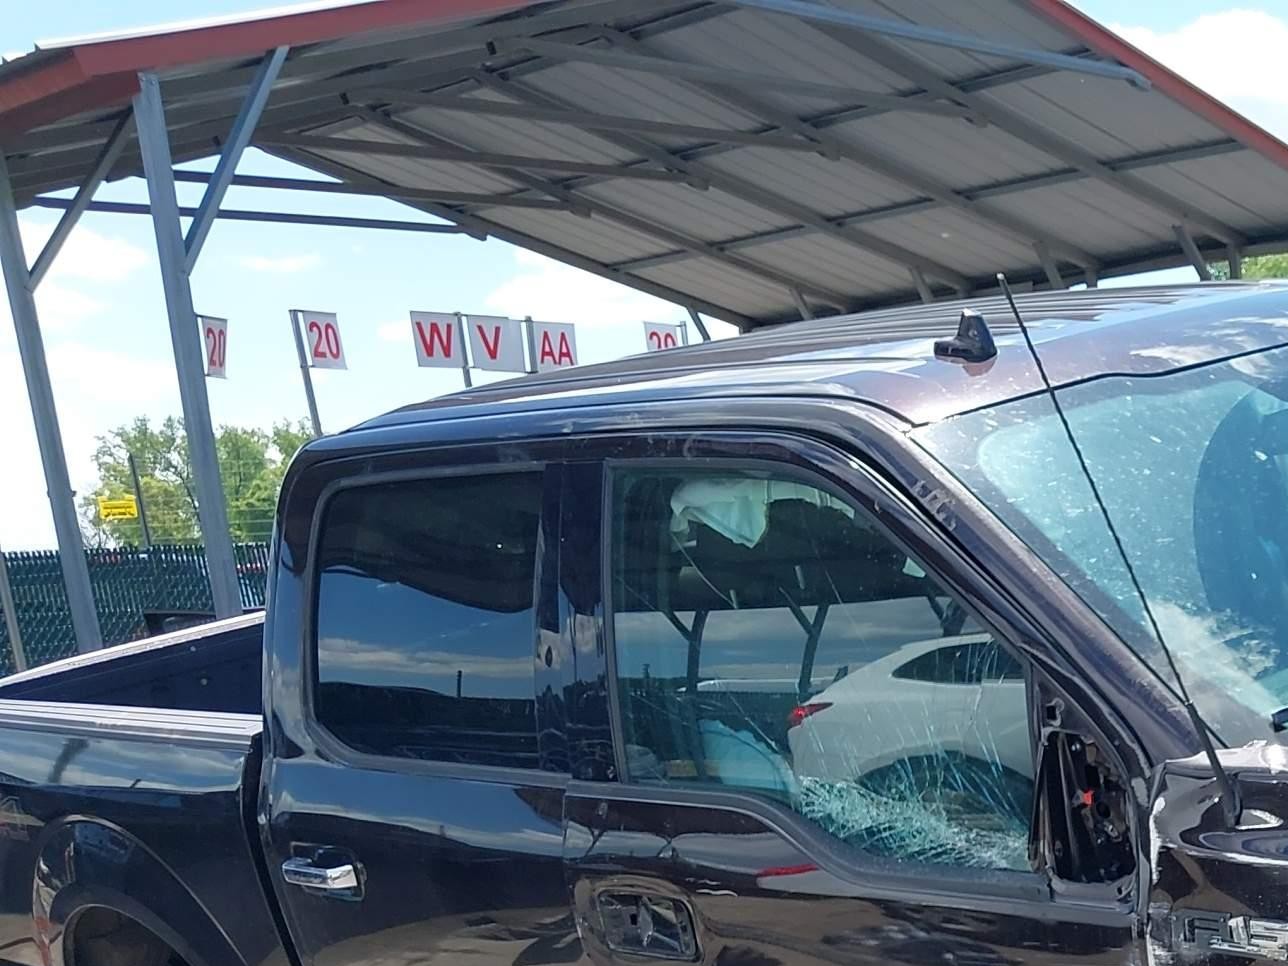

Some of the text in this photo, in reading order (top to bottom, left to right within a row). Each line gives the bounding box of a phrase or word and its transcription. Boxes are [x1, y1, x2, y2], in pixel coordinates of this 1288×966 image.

[206, 326, 226, 369] 20
[308, 320, 341, 360] 20
[415, 320, 453, 359] W
[475, 323, 502, 361] V
[540, 329, 575, 366] AA
